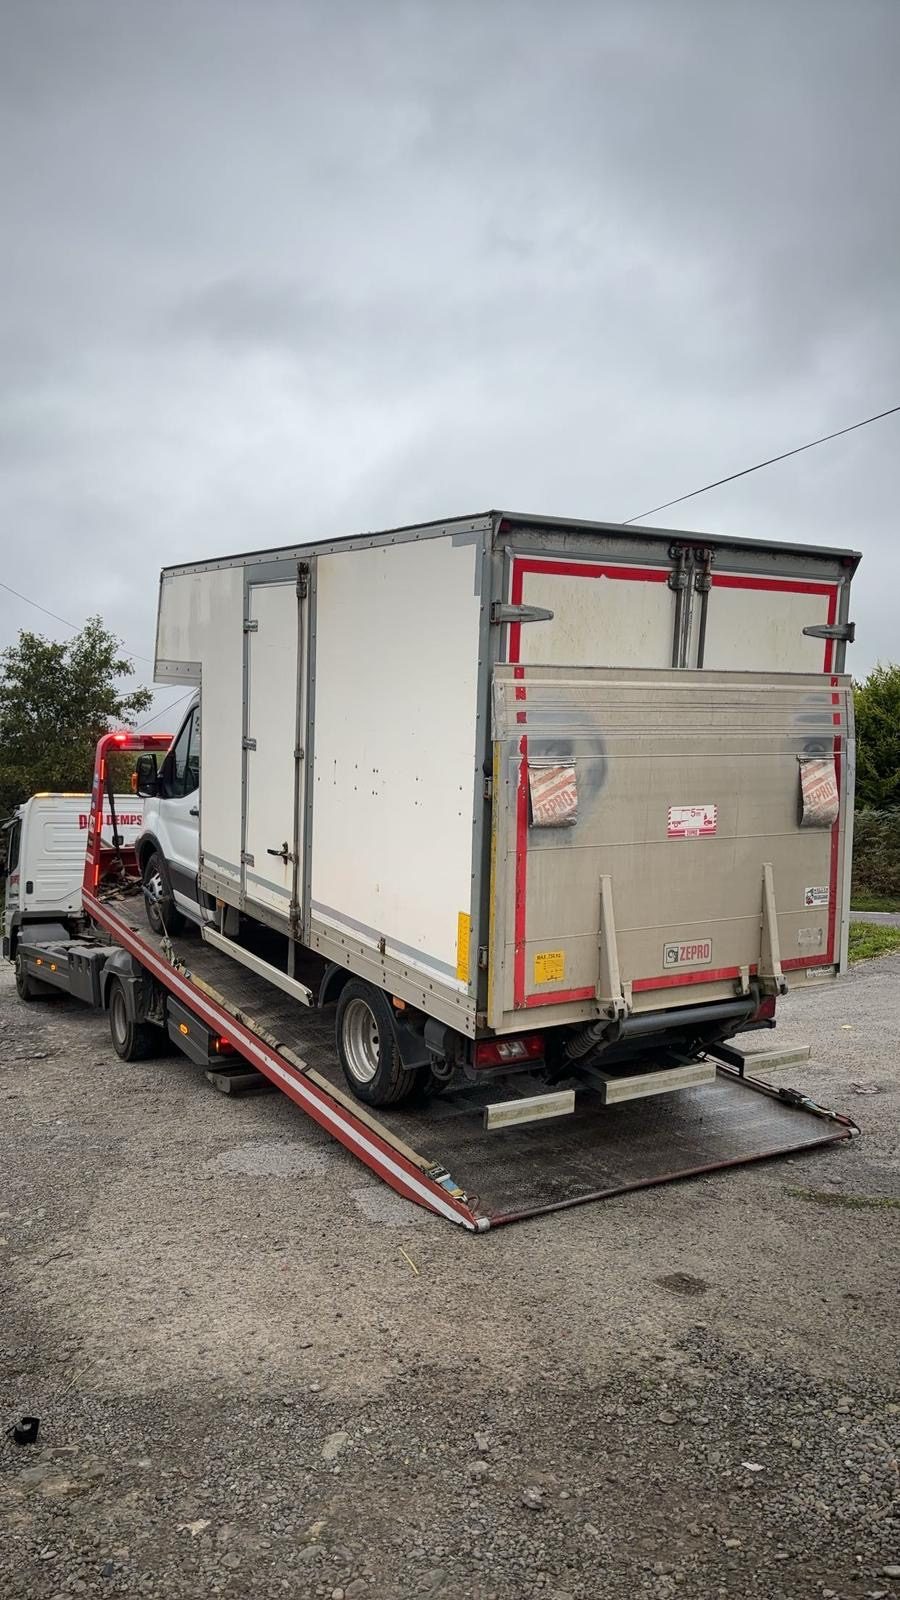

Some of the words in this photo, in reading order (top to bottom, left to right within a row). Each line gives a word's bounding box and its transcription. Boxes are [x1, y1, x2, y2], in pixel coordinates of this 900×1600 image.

[805, 782, 834, 802] ZEPRO
[535, 790, 574, 819] ZEPRO
[690, 808, 696, 817] 5
[679, 943, 710, 961] ZEPRO
